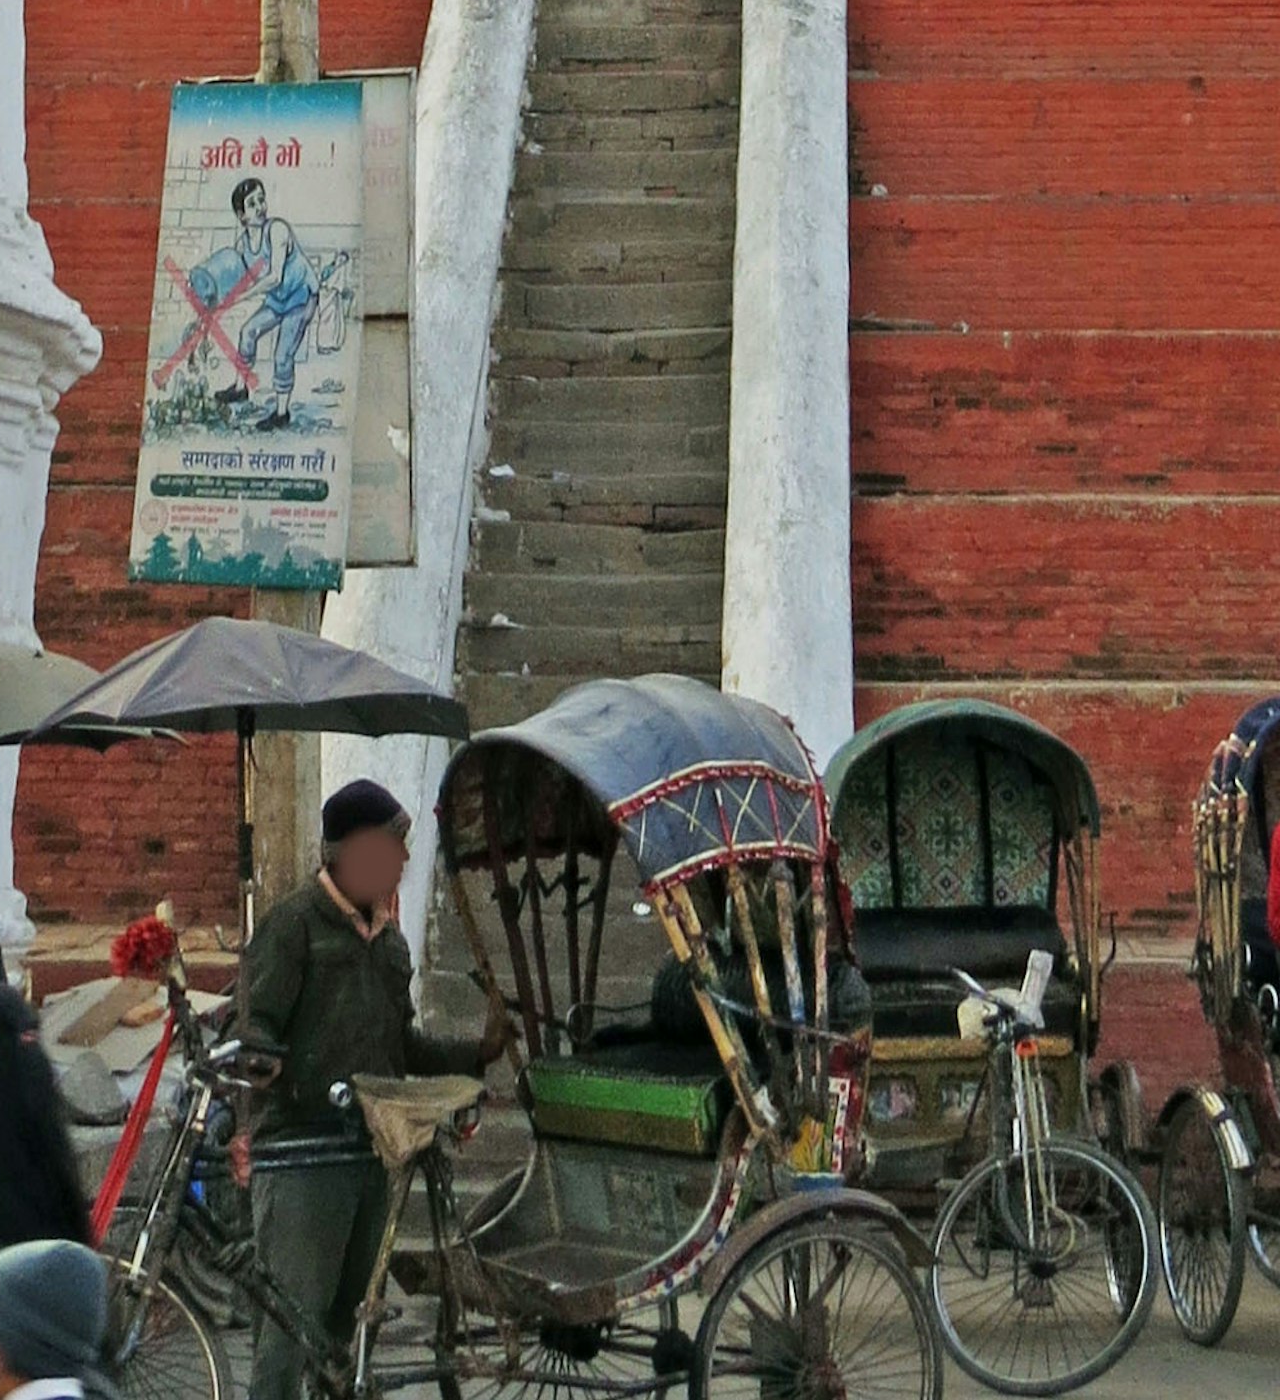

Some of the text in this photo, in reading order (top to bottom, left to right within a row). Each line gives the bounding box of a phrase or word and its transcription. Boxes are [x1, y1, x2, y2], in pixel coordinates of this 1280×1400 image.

[201, 136, 243, 169] अति
[250, 135, 269, 168] नै
[276, 136, 302, 168] भो
[247, 448, 296, 472] संरक्षण
